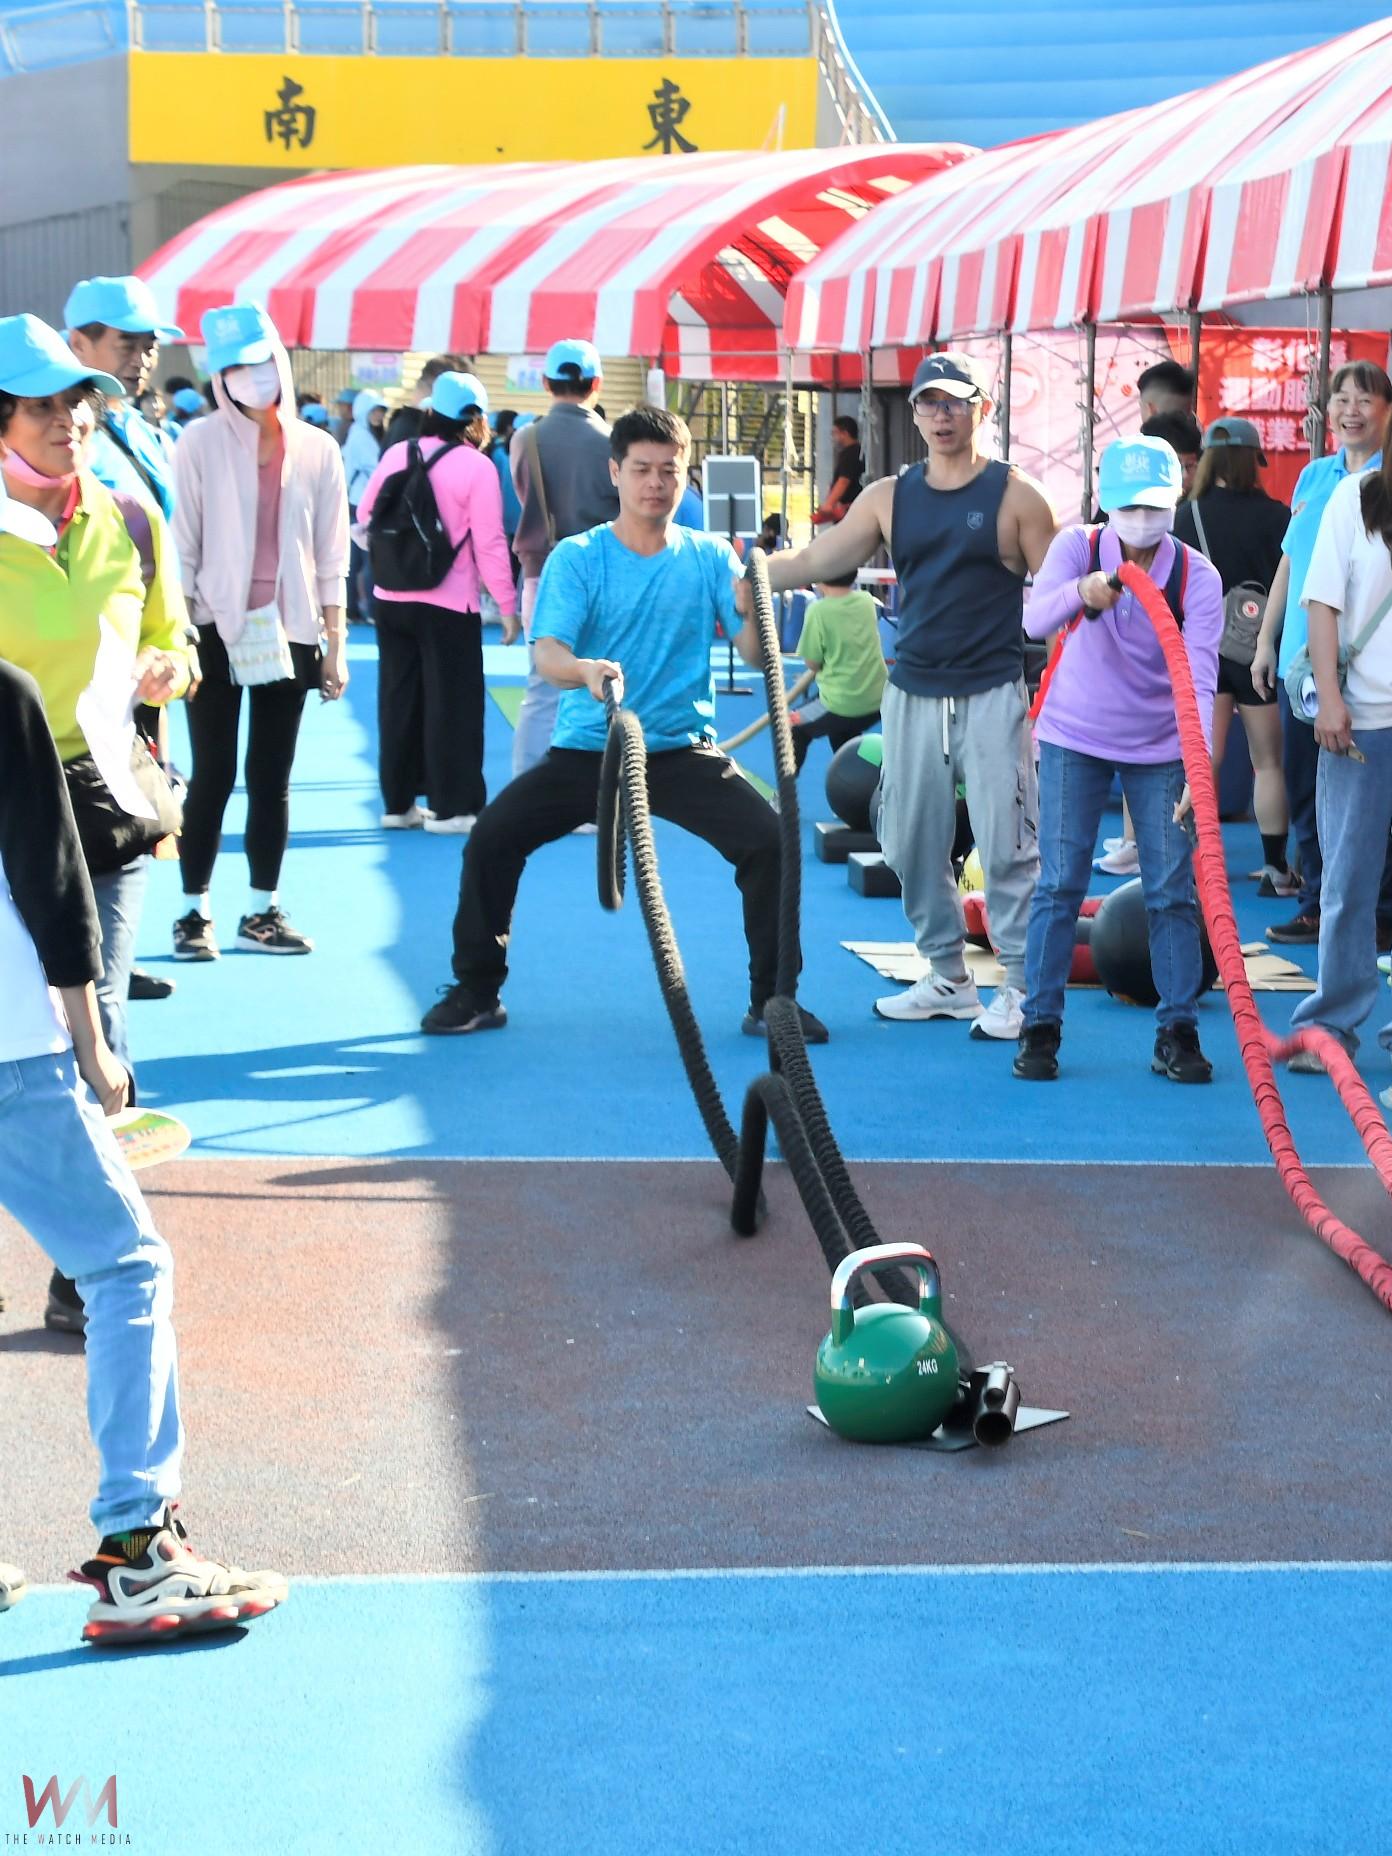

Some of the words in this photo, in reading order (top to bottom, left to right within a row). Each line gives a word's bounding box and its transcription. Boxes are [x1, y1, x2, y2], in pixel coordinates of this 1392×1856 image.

[264, 75, 316, 151] 南
[642, 77, 699, 154] 東
[916, 1358, 939, 1376] 24KG
